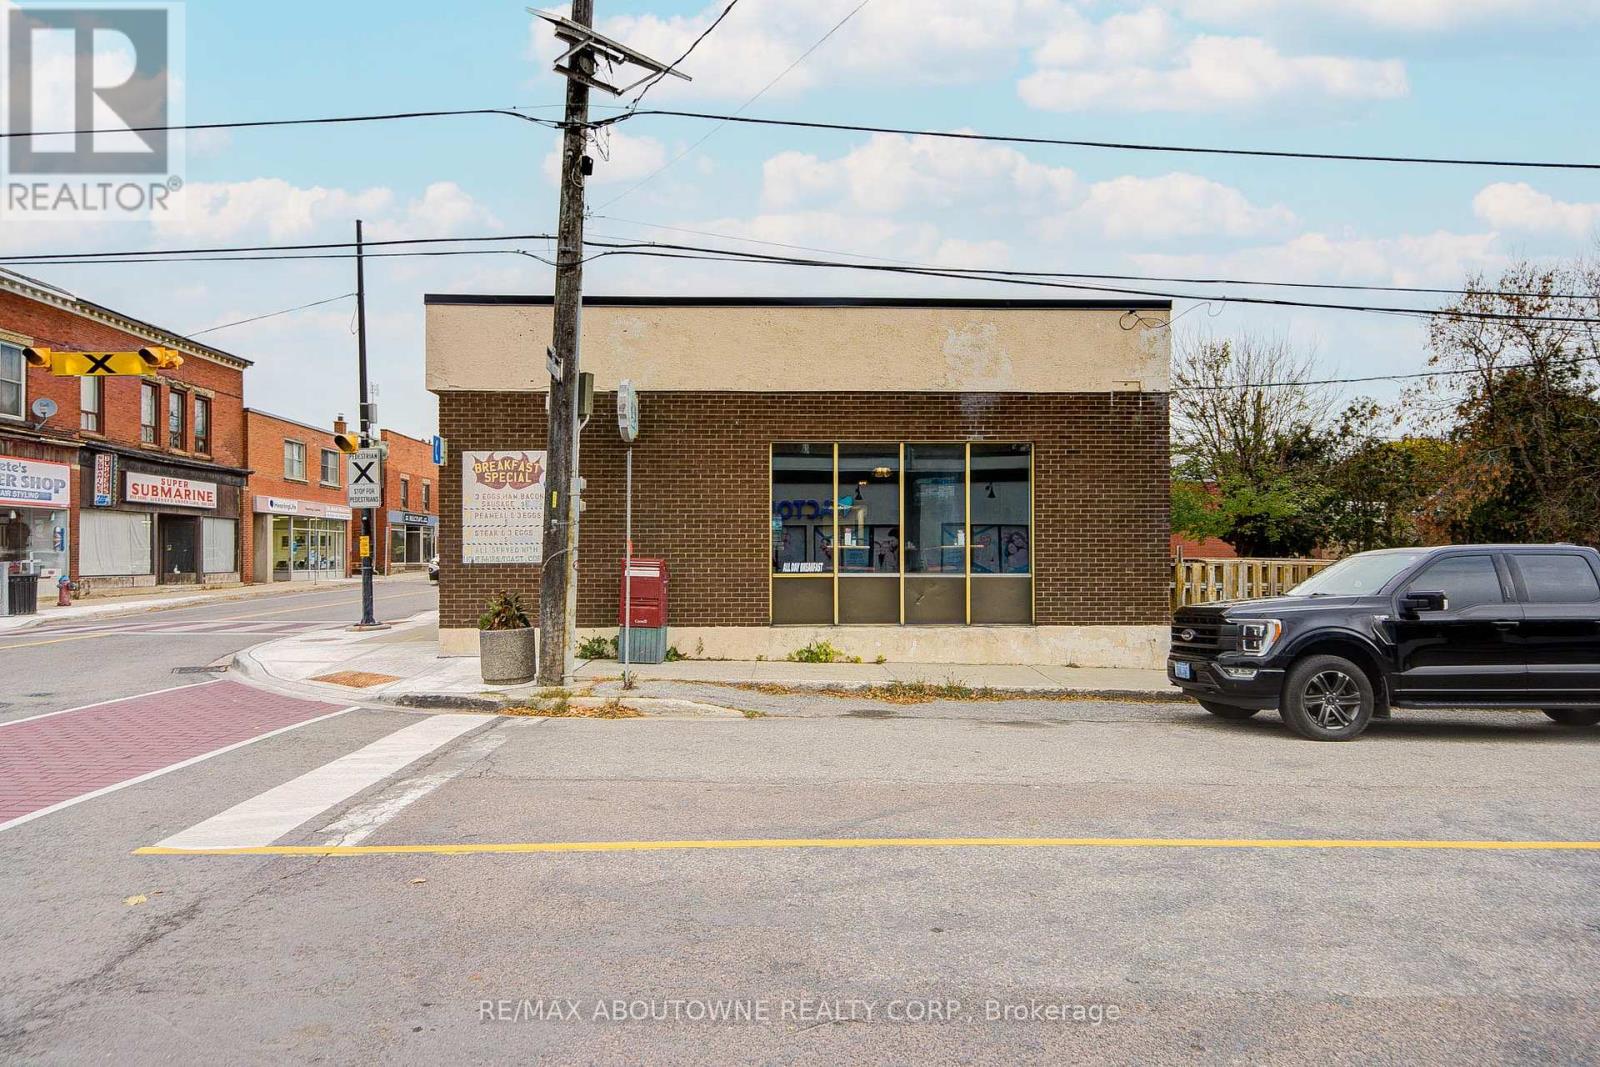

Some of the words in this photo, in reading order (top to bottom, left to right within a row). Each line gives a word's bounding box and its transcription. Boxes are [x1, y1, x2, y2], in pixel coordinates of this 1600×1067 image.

[474, 459, 541, 474] BREAKFAST
[20, 475, 66, 494] SHOP
[160, 478, 189, 489] SUPER
[484, 472, 532, 483] SPECIAL
[131, 483, 214, 502] SUBMARINE
